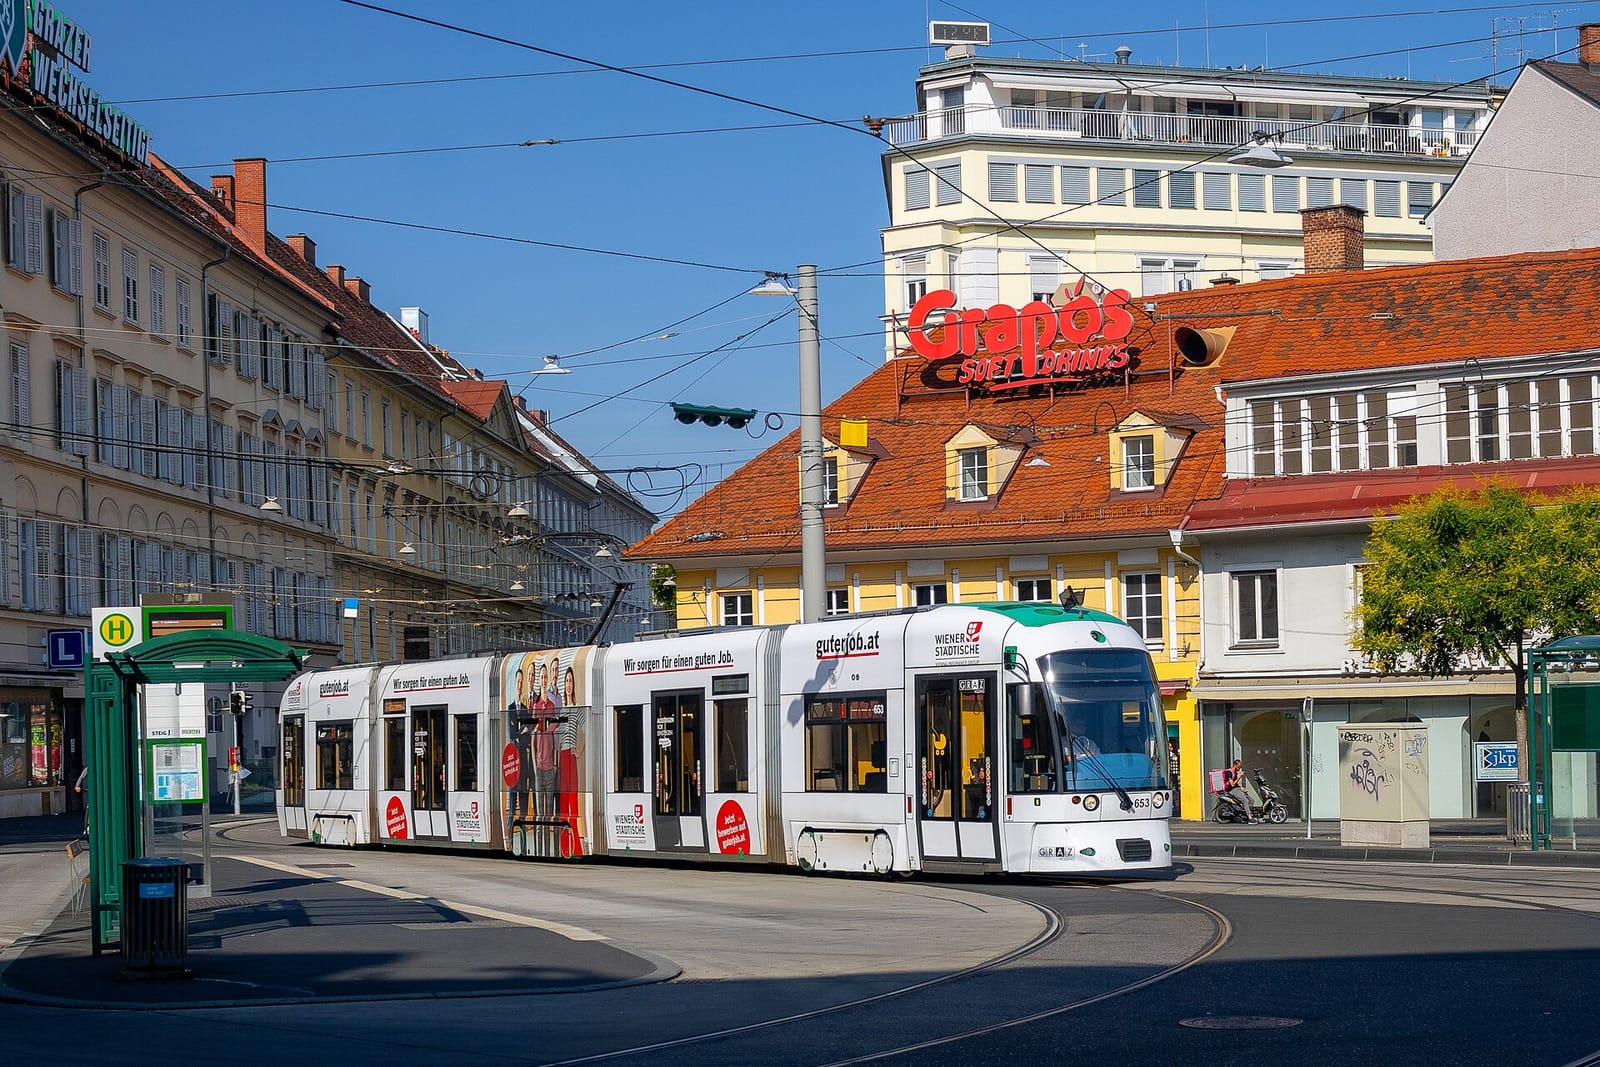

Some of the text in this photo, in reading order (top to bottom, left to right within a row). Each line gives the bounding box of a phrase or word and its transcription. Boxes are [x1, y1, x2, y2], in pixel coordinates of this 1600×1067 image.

[32, 0, 94, 73] GRAZER
[958, 343, 1130, 384] SOFT DRINKS
[107, 621, 125, 640] H
[816, 630, 879, 657] guterjob.at
[935, 632, 966, 646] WIENER
[58, 638, 75, 661] L
[935, 644, 980, 657] STÄDTISCHE
[624, 650, 734, 672] Wir sorgen für einen guten Job.
[958, 679, 985, 691] GRAZ
[873, 704, 884, 714] 653
[1492, 750, 1516, 767] jkp
[1134, 798, 1150, 809] 653
[614, 814, 635, 825] WIENER
[1038, 847, 1075, 857] GRAZ
